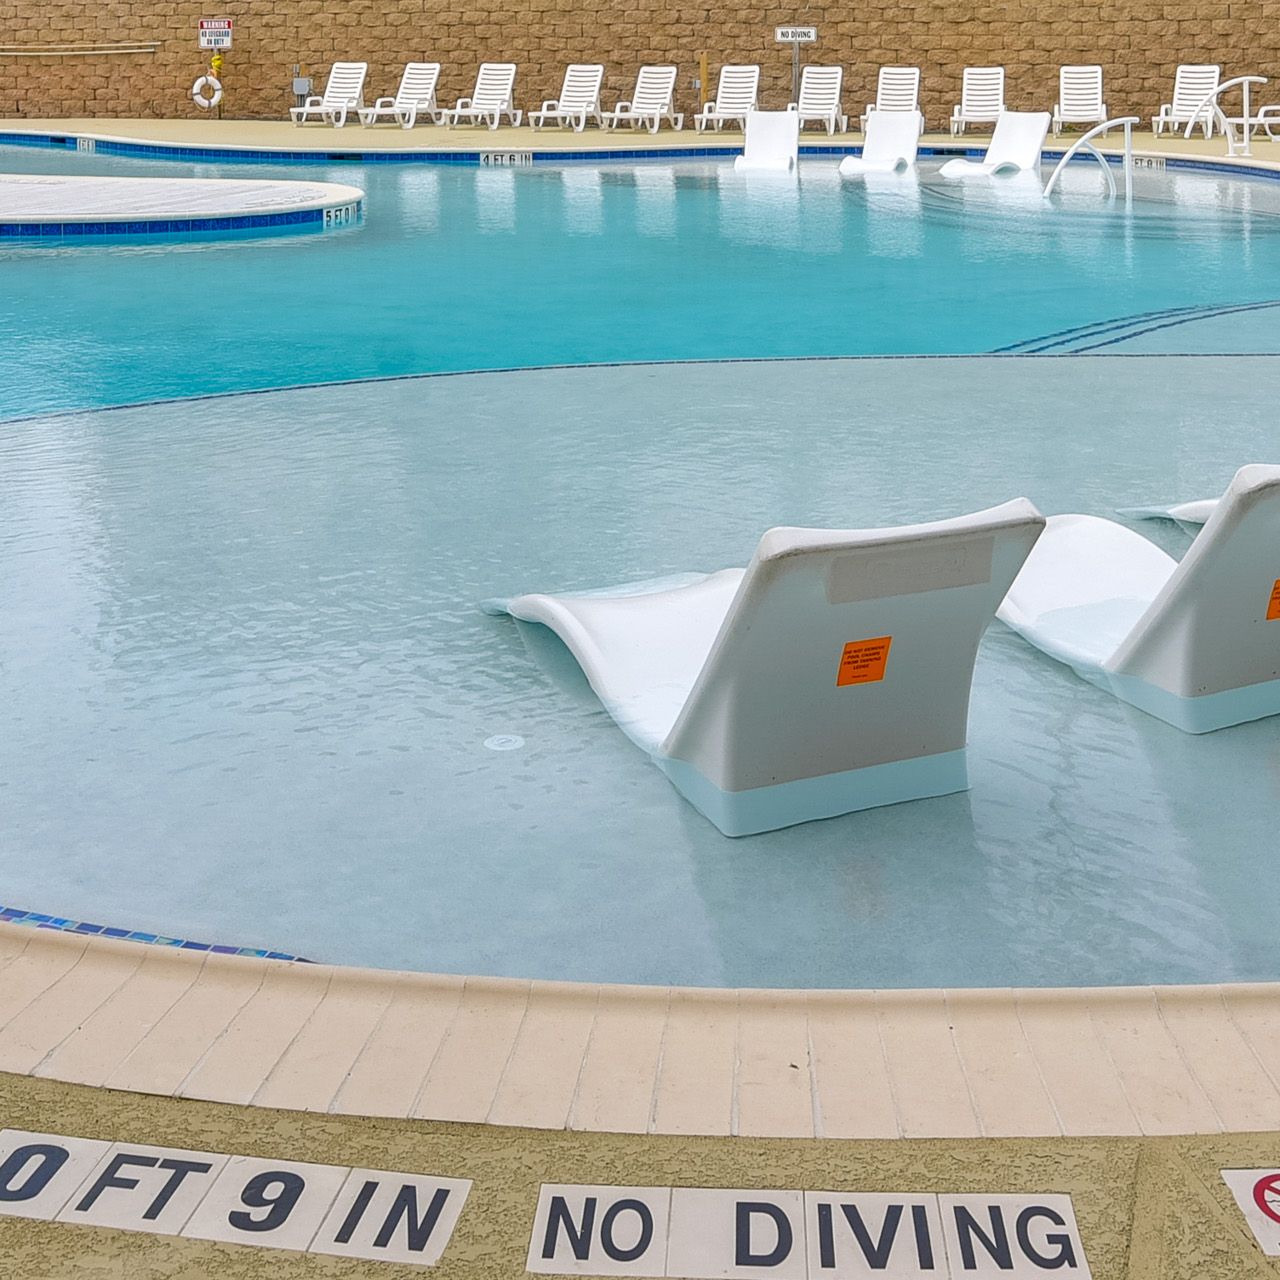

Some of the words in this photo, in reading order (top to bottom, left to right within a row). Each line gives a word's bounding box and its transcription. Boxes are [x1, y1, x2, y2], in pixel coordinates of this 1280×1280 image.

[780, 30, 790, 39] NO
[791, 30, 812, 39] DIVING
[494, 154, 505, 165] FT
[326, 210, 331, 224] 5
[74, 1152, 212, 1220] FT
[227, 1170, 306, 1233] 9
[333, 1180, 450, 1252] IN
[540, 1195, 655, 1262] NO
[734, 1200, 1078, 1269] DIVING
